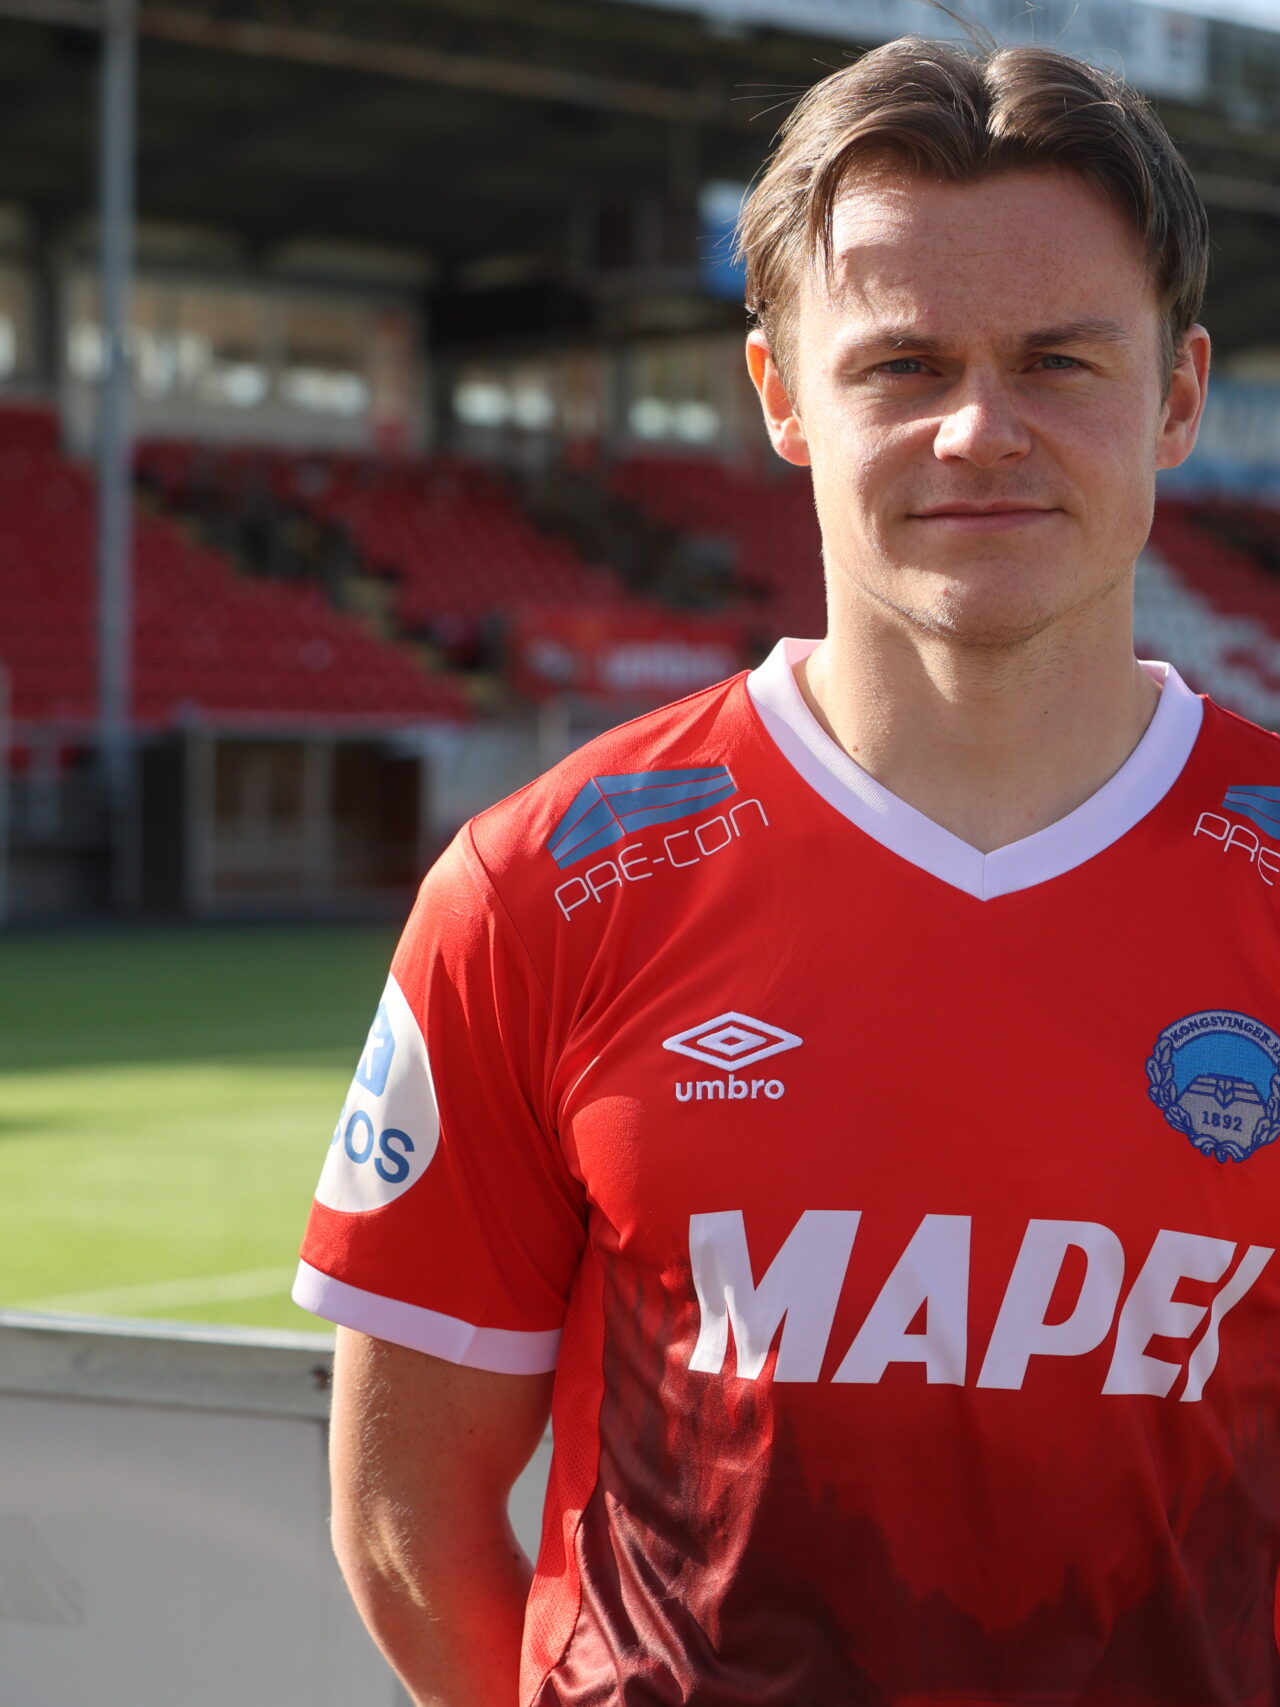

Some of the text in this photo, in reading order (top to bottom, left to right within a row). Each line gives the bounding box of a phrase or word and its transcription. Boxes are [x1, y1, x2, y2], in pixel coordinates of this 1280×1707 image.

[675, 1074, 785, 1102] umbro
[1202, 1111, 1243, 1132] 1892
[687, 1209, 1276, 1402] MAPEI
